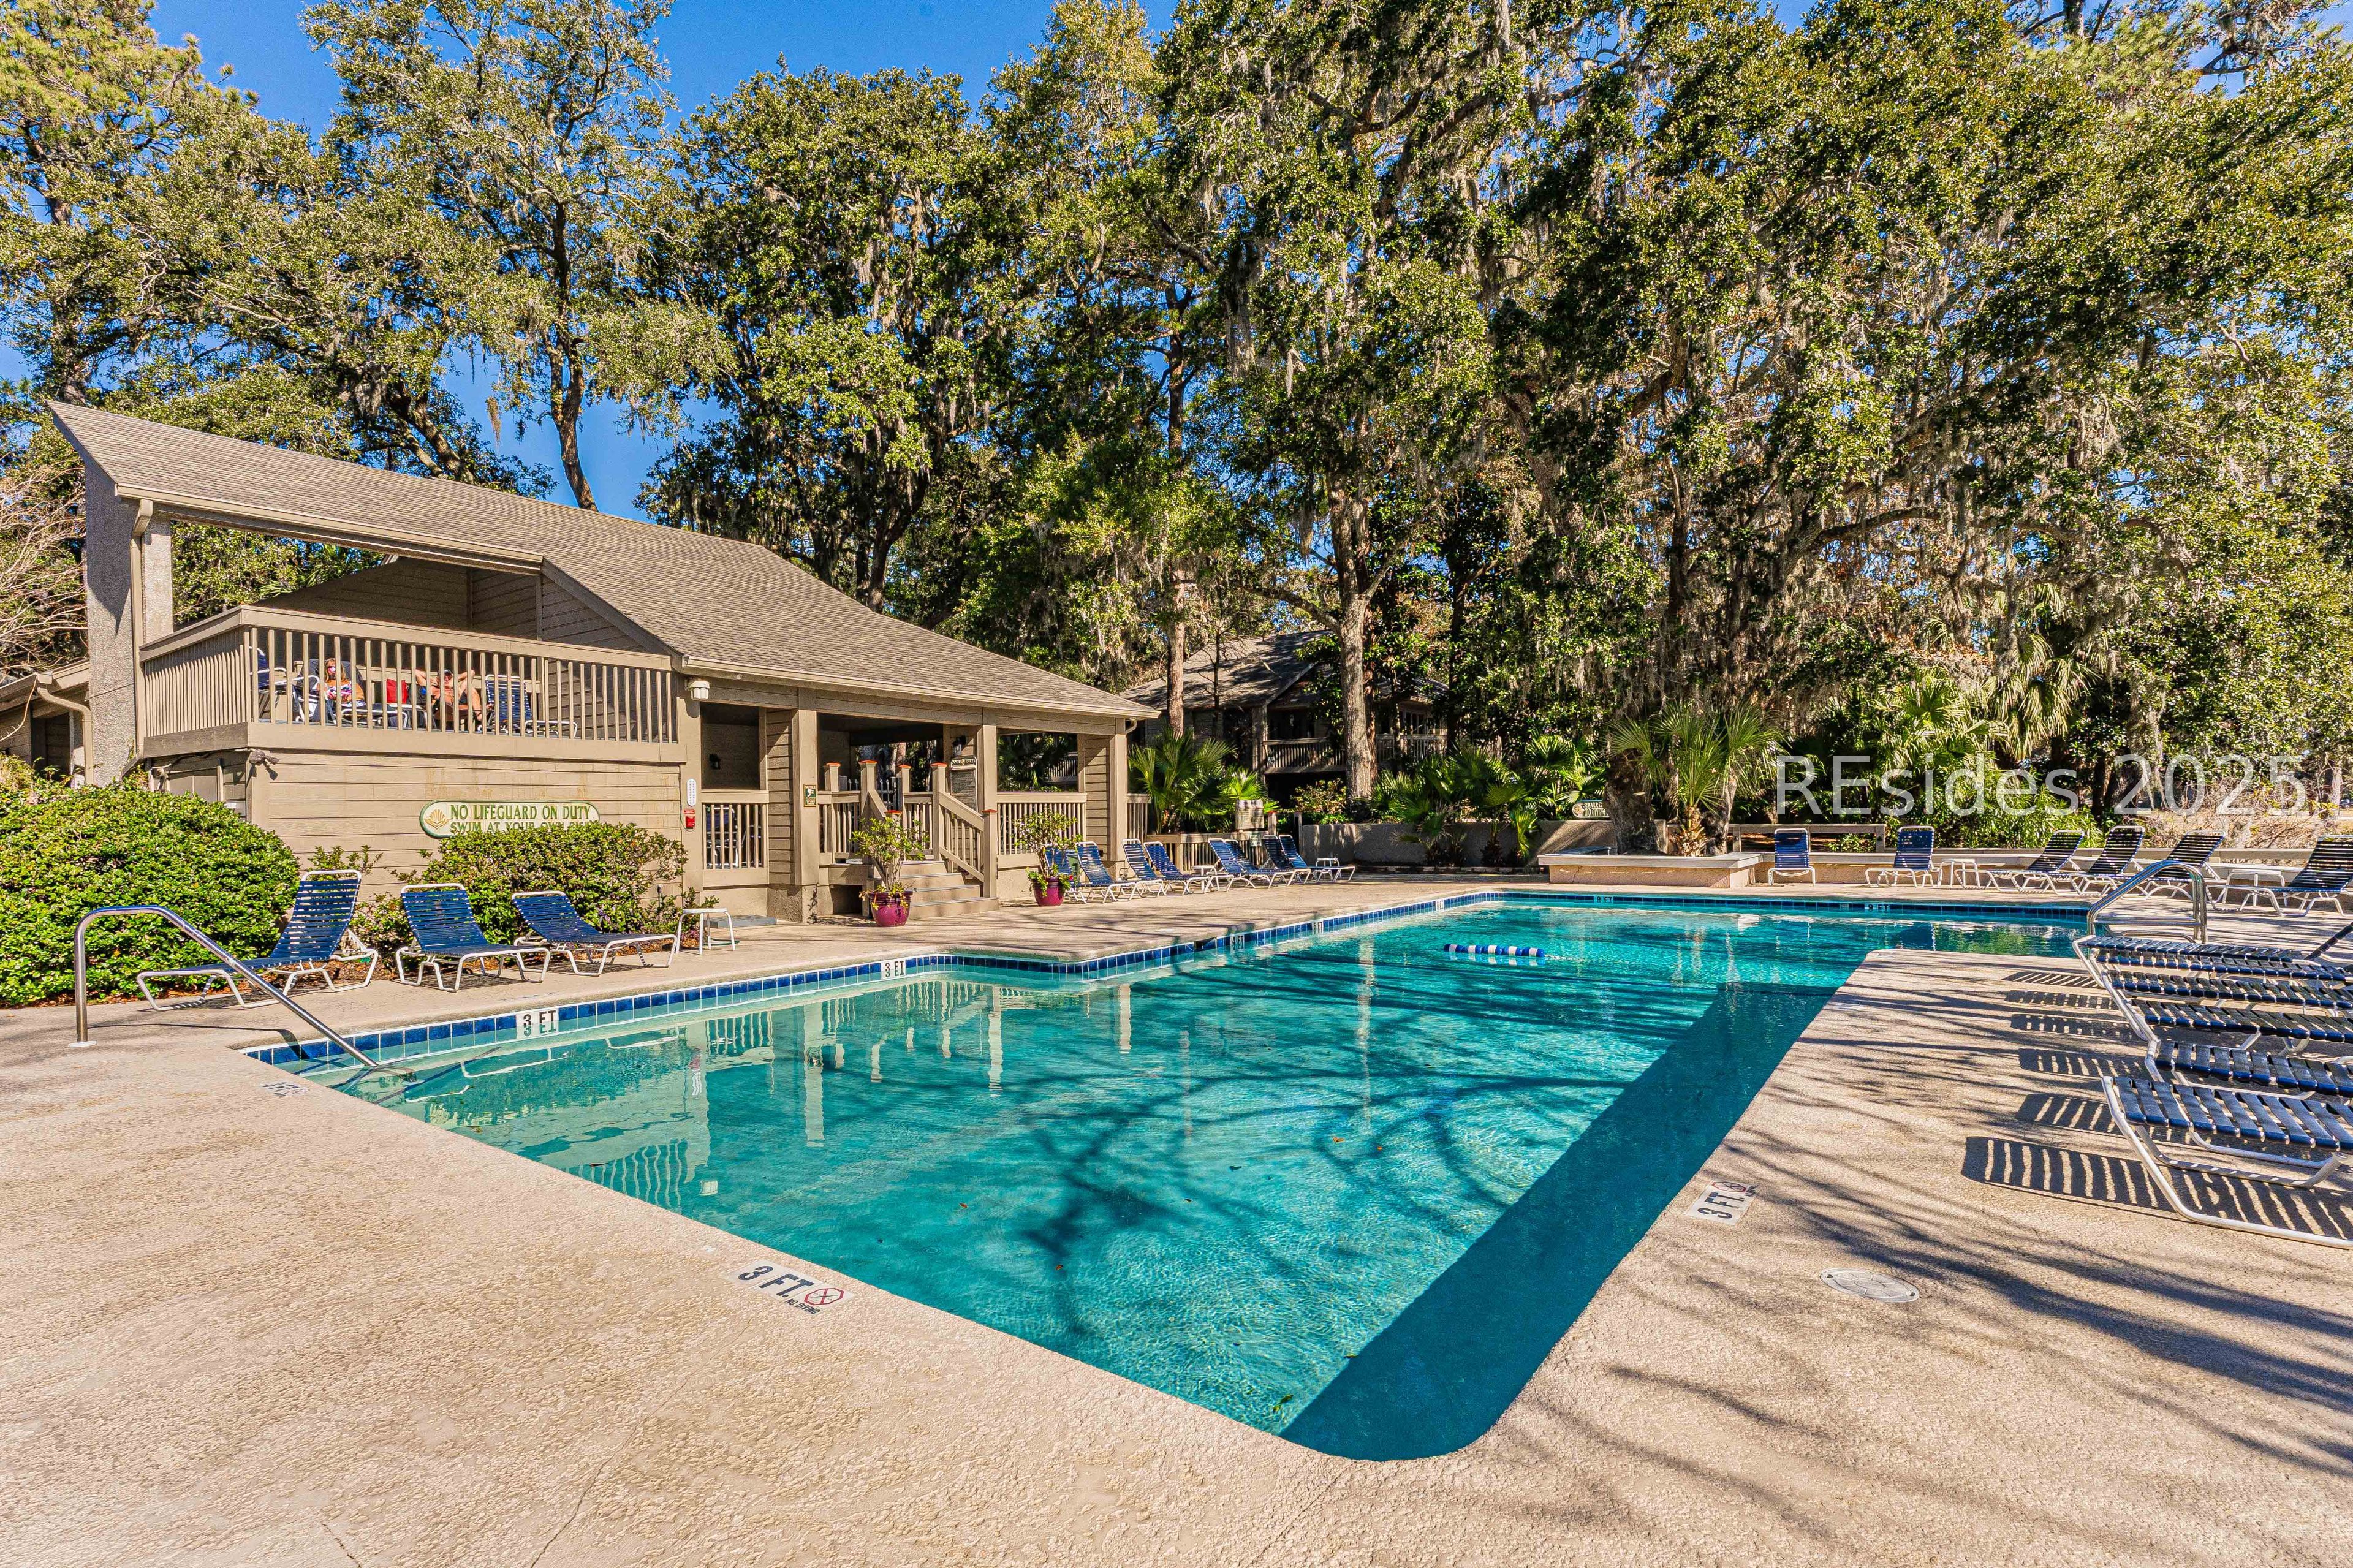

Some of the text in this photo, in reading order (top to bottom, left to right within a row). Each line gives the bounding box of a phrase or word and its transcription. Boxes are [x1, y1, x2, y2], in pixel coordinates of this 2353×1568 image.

[450, 805, 591, 820] NO LIFEGUARD ON DUTY
[450, 822, 482, 833] SWIM
[487, 822, 500, 833] AT
[1697, 1207, 1733, 1219] 3
[738, 1265, 774, 1281] 3
[794, 1302, 821, 1314] DIVING
